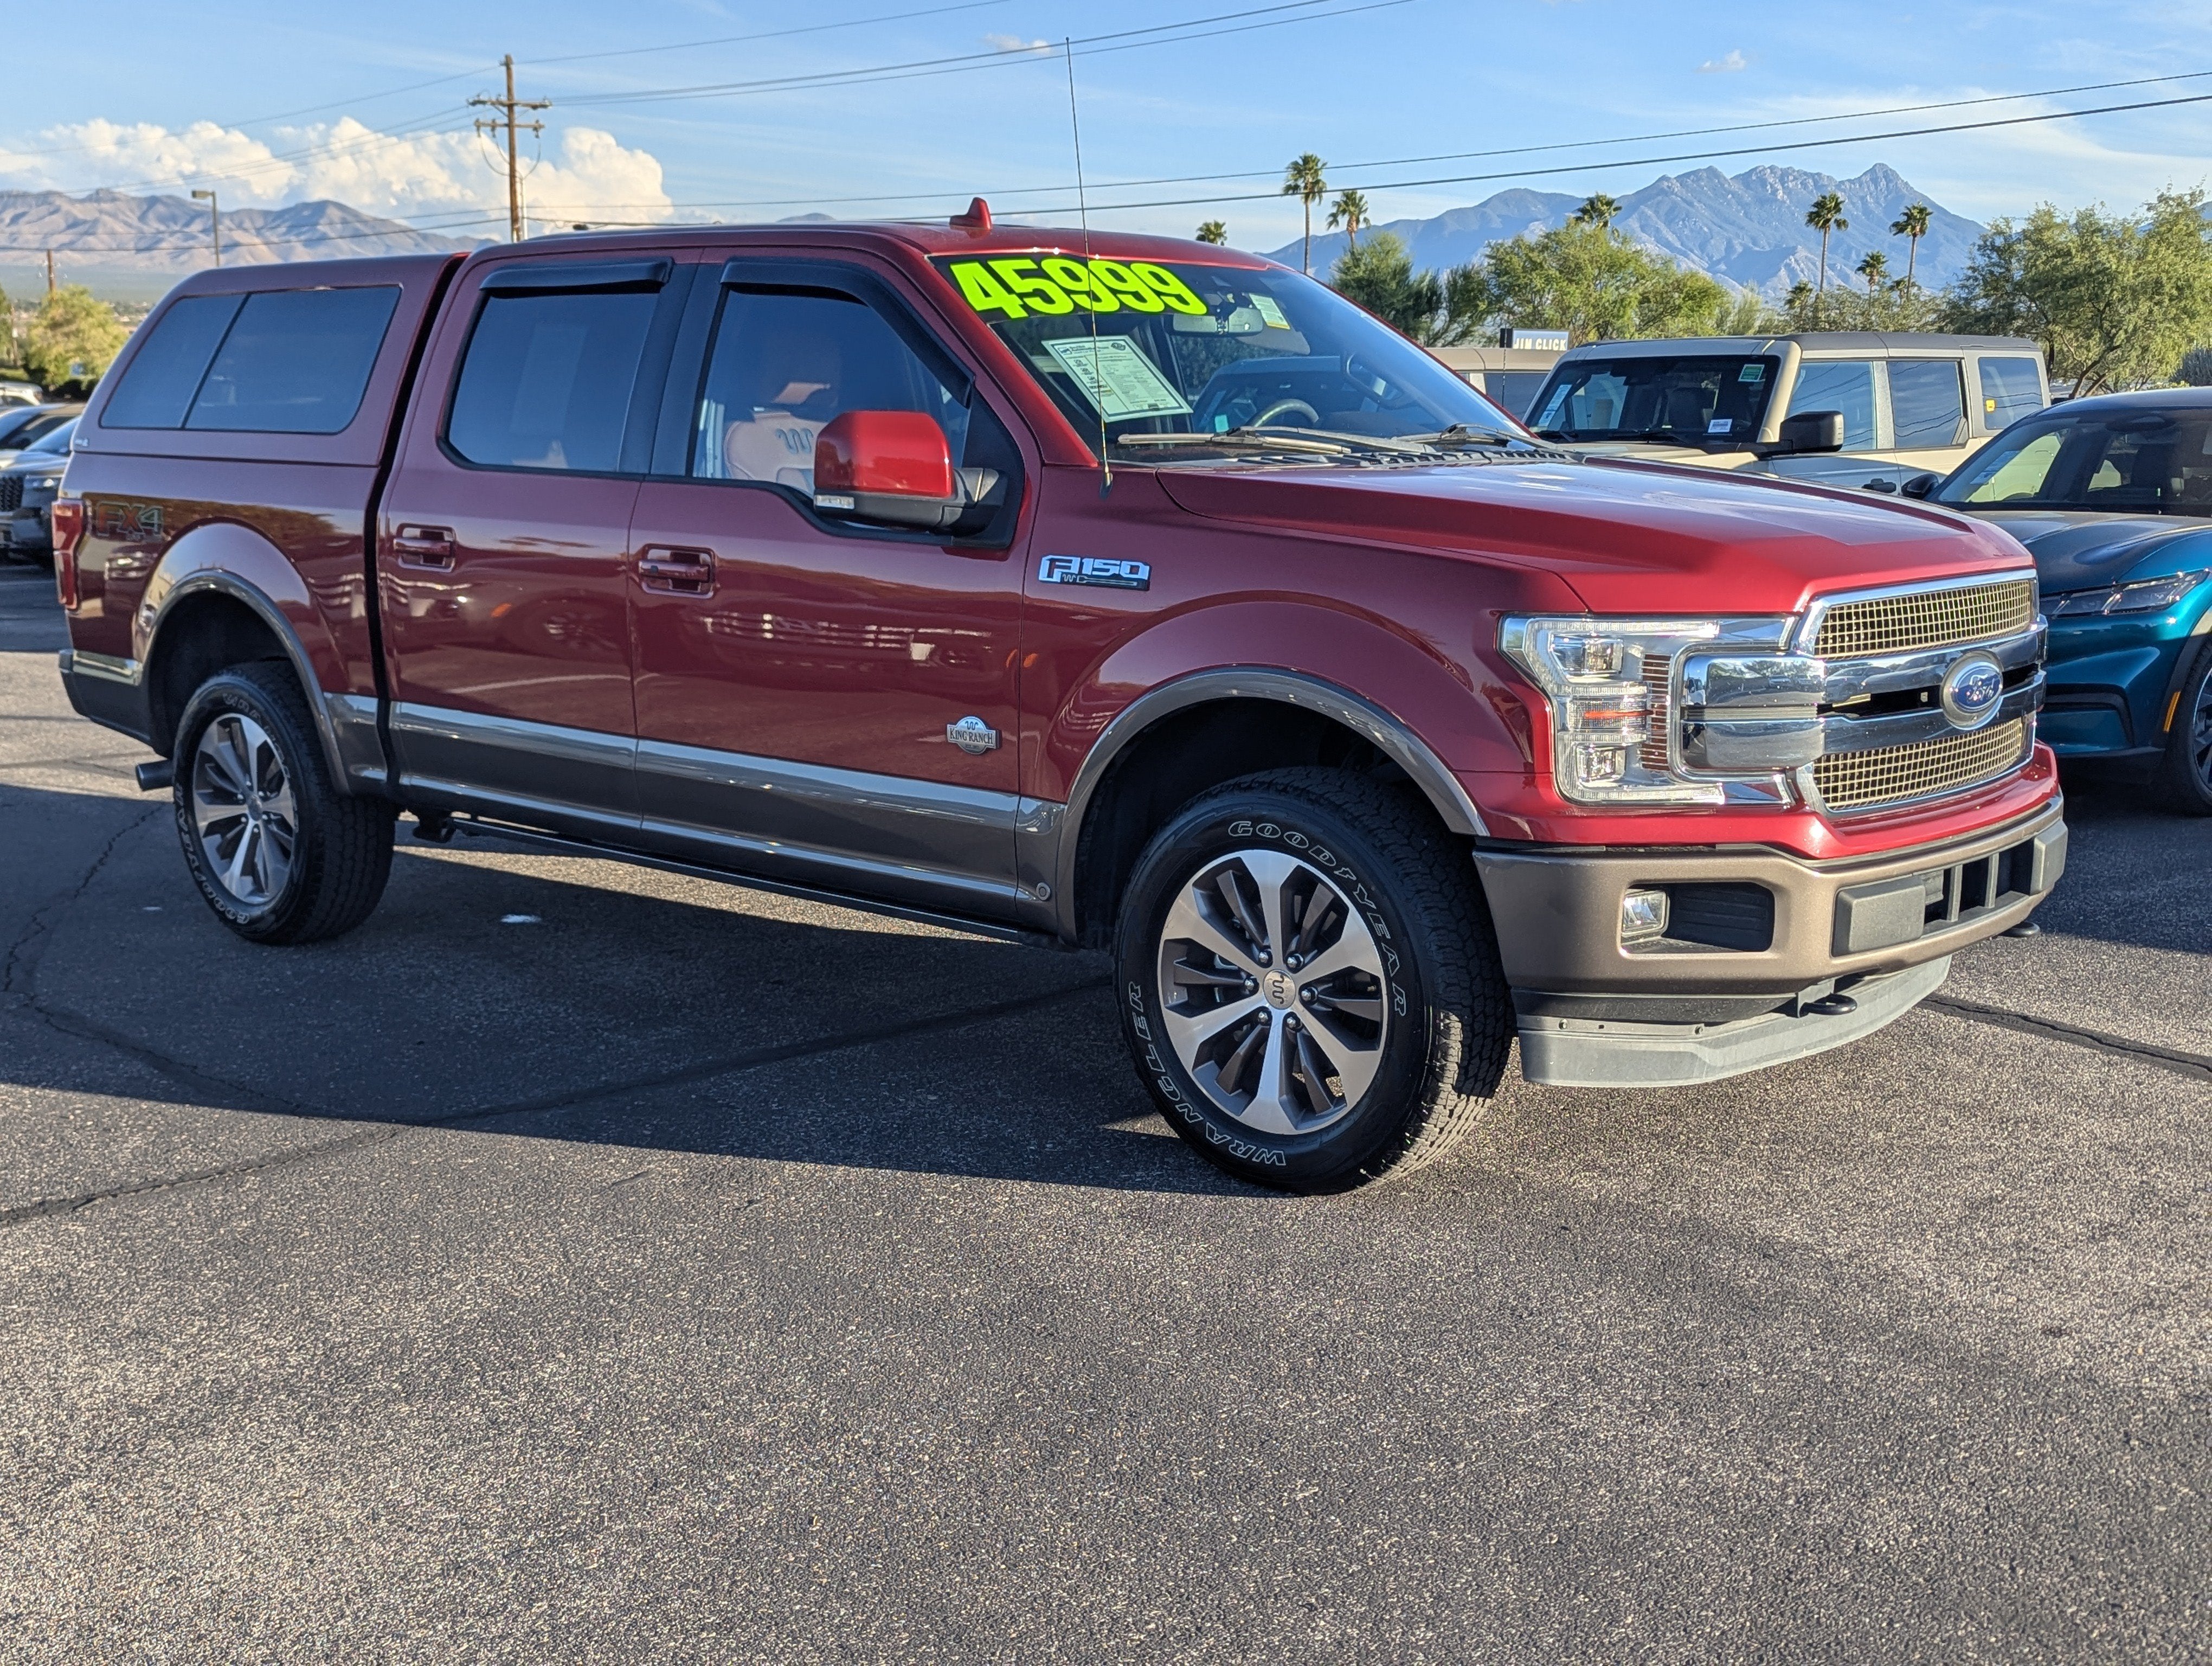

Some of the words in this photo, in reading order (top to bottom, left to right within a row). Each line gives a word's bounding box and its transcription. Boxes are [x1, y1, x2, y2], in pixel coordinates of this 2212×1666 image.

[950, 258, 1207, 319] 45999
[1513, 337, 1532, 350] JIM
[1535, 338, 1567, 351] CLICK
[96, 500, 164, 537] FX4
[950, 727, 967, 741] KING
[968, 732, 993, 745] RANCH
[1228, 821, 1407, 1016] GOODYEAR
[1128, 981, 1287, 1166] WRANGLER
